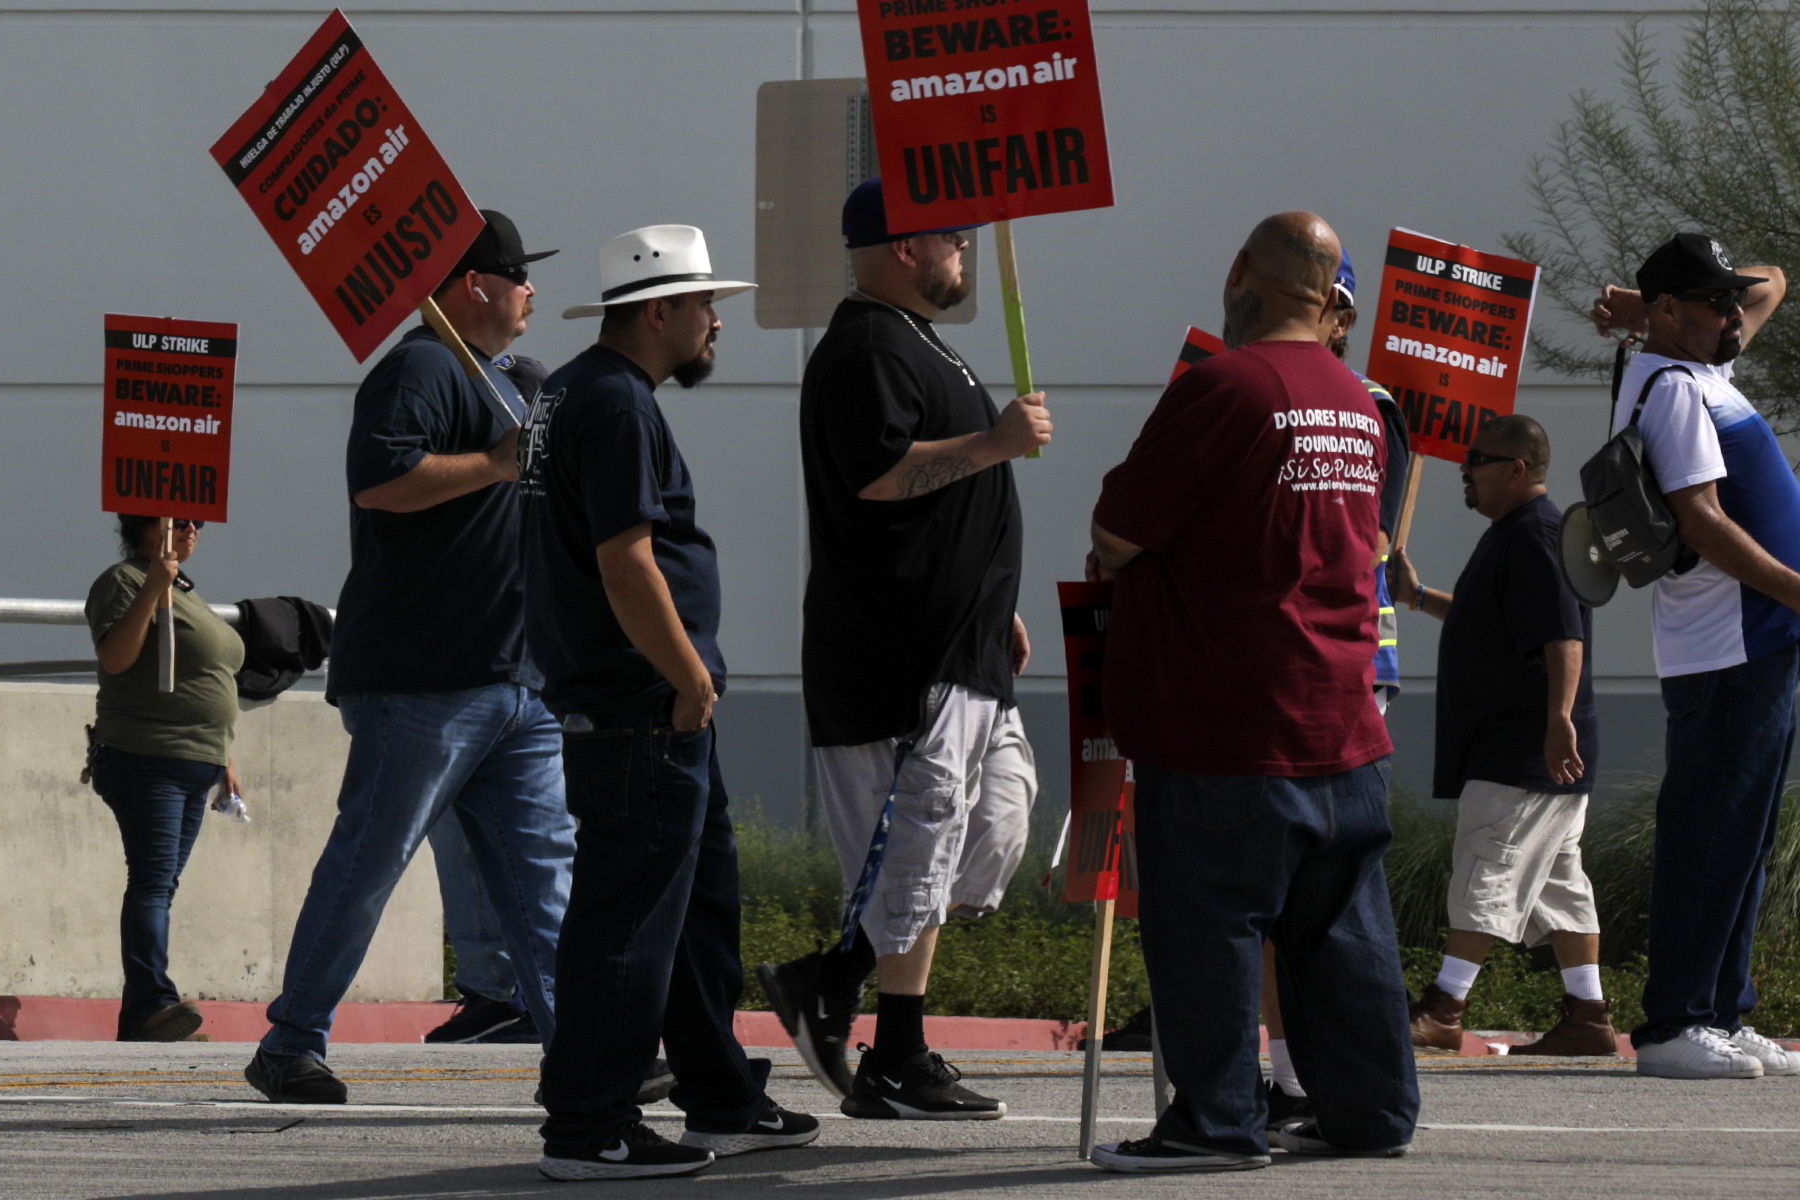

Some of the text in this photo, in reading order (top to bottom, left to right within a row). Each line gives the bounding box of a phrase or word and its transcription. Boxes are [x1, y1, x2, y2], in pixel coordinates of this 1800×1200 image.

[884, 10, 1073, 62] BEWARE:
[890, 52, 1077, 102] amazon air
[240, 44, 349, 168] HUELGA DE TRABAJO INJUSTO (ULP)
[981, 104, 996, 124] IS
[259, 69, 367, 193] COMPRADORES de PRIME
[274, 96, 388, 221] CUIDADO:
[903, 126, 1091, 205] UNFAIR
[297, 124, 410, 254] amazon air
[362, 204, 383, 227] ES
[334, 180, 458, 326] INJUSTO
[1417, 256, 1503, 291] ULP STRIKE
[1396, 279, 1517, 319] PRIME SHOPPERS
[132, 334, 209, 353] ULP STRIKE
[1391, 300, 1512, 350] BEWARE:
[116, 359, 224, 378] PRIME SHOPPERS
[1386, 335, 1507, 378] amazon air
[116, 378, 222, 407] BEWARE:
[1439, 373, 1449, 387] IS
[114, 411, 221, 435] amazon air
[1274, 408, 1380, 437] DOLORES HUERTA
[162, 440, 170, 451] IS
[1294, 435, 1374, 457] FOUNDATION
[116, 457, 217, 505] UNFAIR
[1278, 458, 1309, 484] ¡Sí
[1311, 458, 1333, 479] Se
